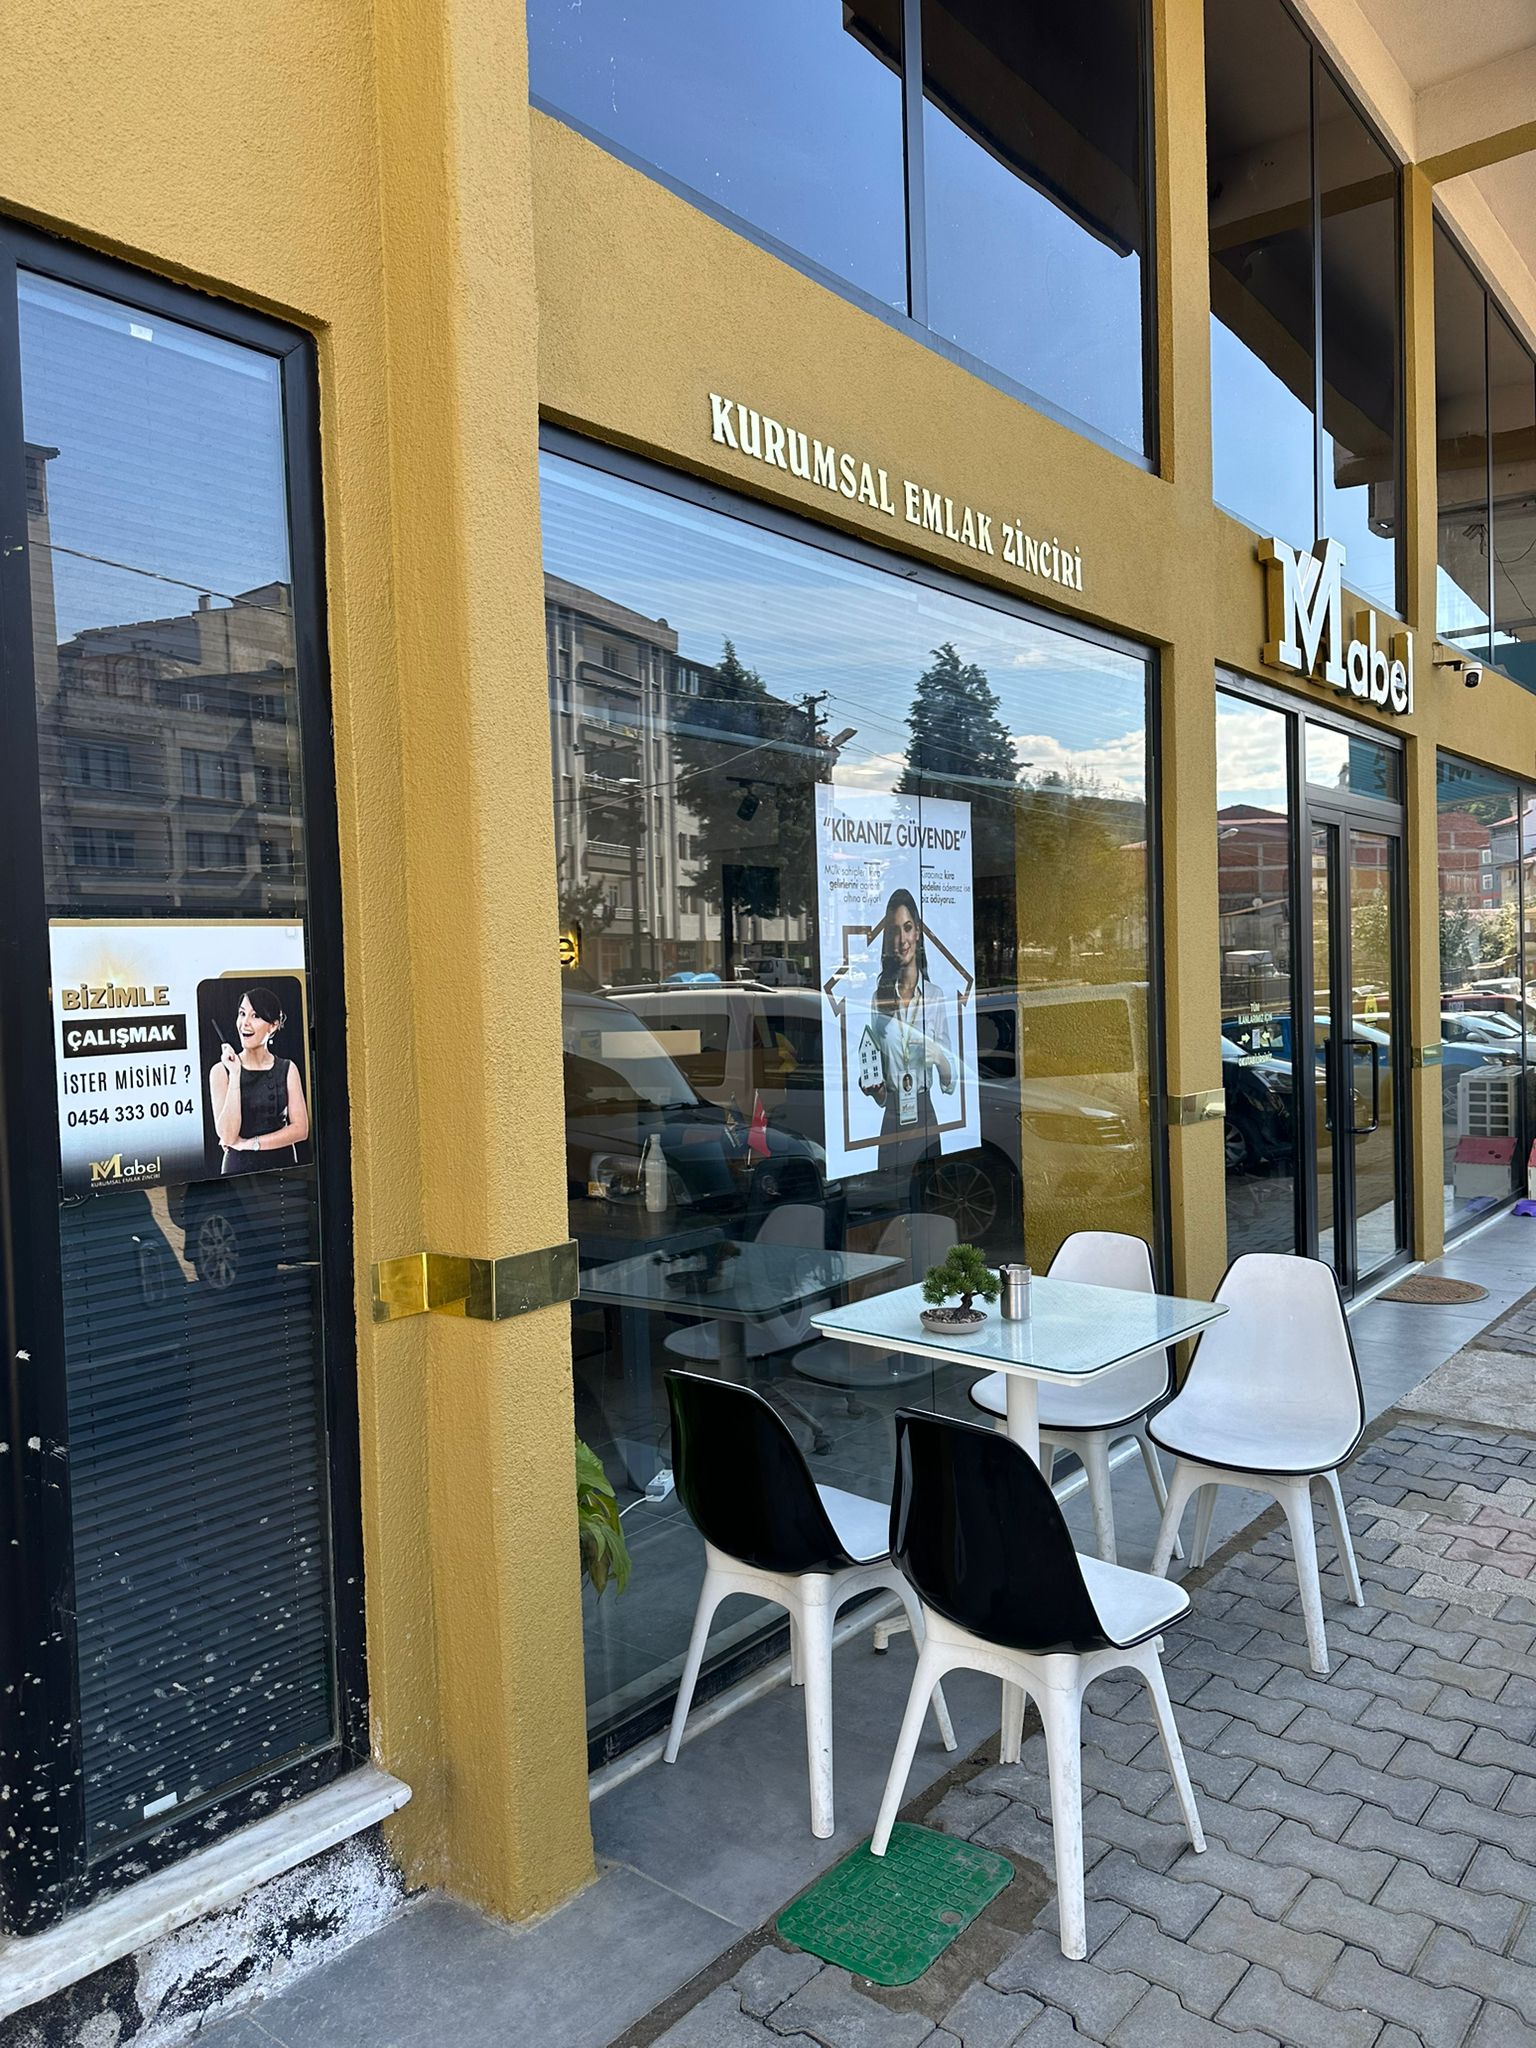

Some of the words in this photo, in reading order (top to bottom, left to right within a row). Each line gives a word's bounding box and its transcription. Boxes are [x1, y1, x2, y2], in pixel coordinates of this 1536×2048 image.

[709, 392, 895, 516] KURUMSAL
[903, 480, 994, 555] EMLAK
[1002, 518, 1083, 591] ZİNCİRİ
[1270, 537, 1414, 715] Mabel
[944, 869, 955, 880] kira
[62, 982, 170, 1010] BİZİMLE
[67, 1025, 176, 1051] ÇALIŞMAK
[63, 1072, 107, 1095] İSTER
[115, 1063, 177, 1090] MİSİNİZ
[184, 1064, 191, 1084] ?
[67, 1108, 109, 1128] 0454
[114, 1104, 145, 1122] 333
[150, 1101, 169, 1118] 00
[175, 1099, 194, 1115] 04
[88, 1153, 161, 1181] Mabel
[91, 1180, 121, 1188] KURUMSAL
